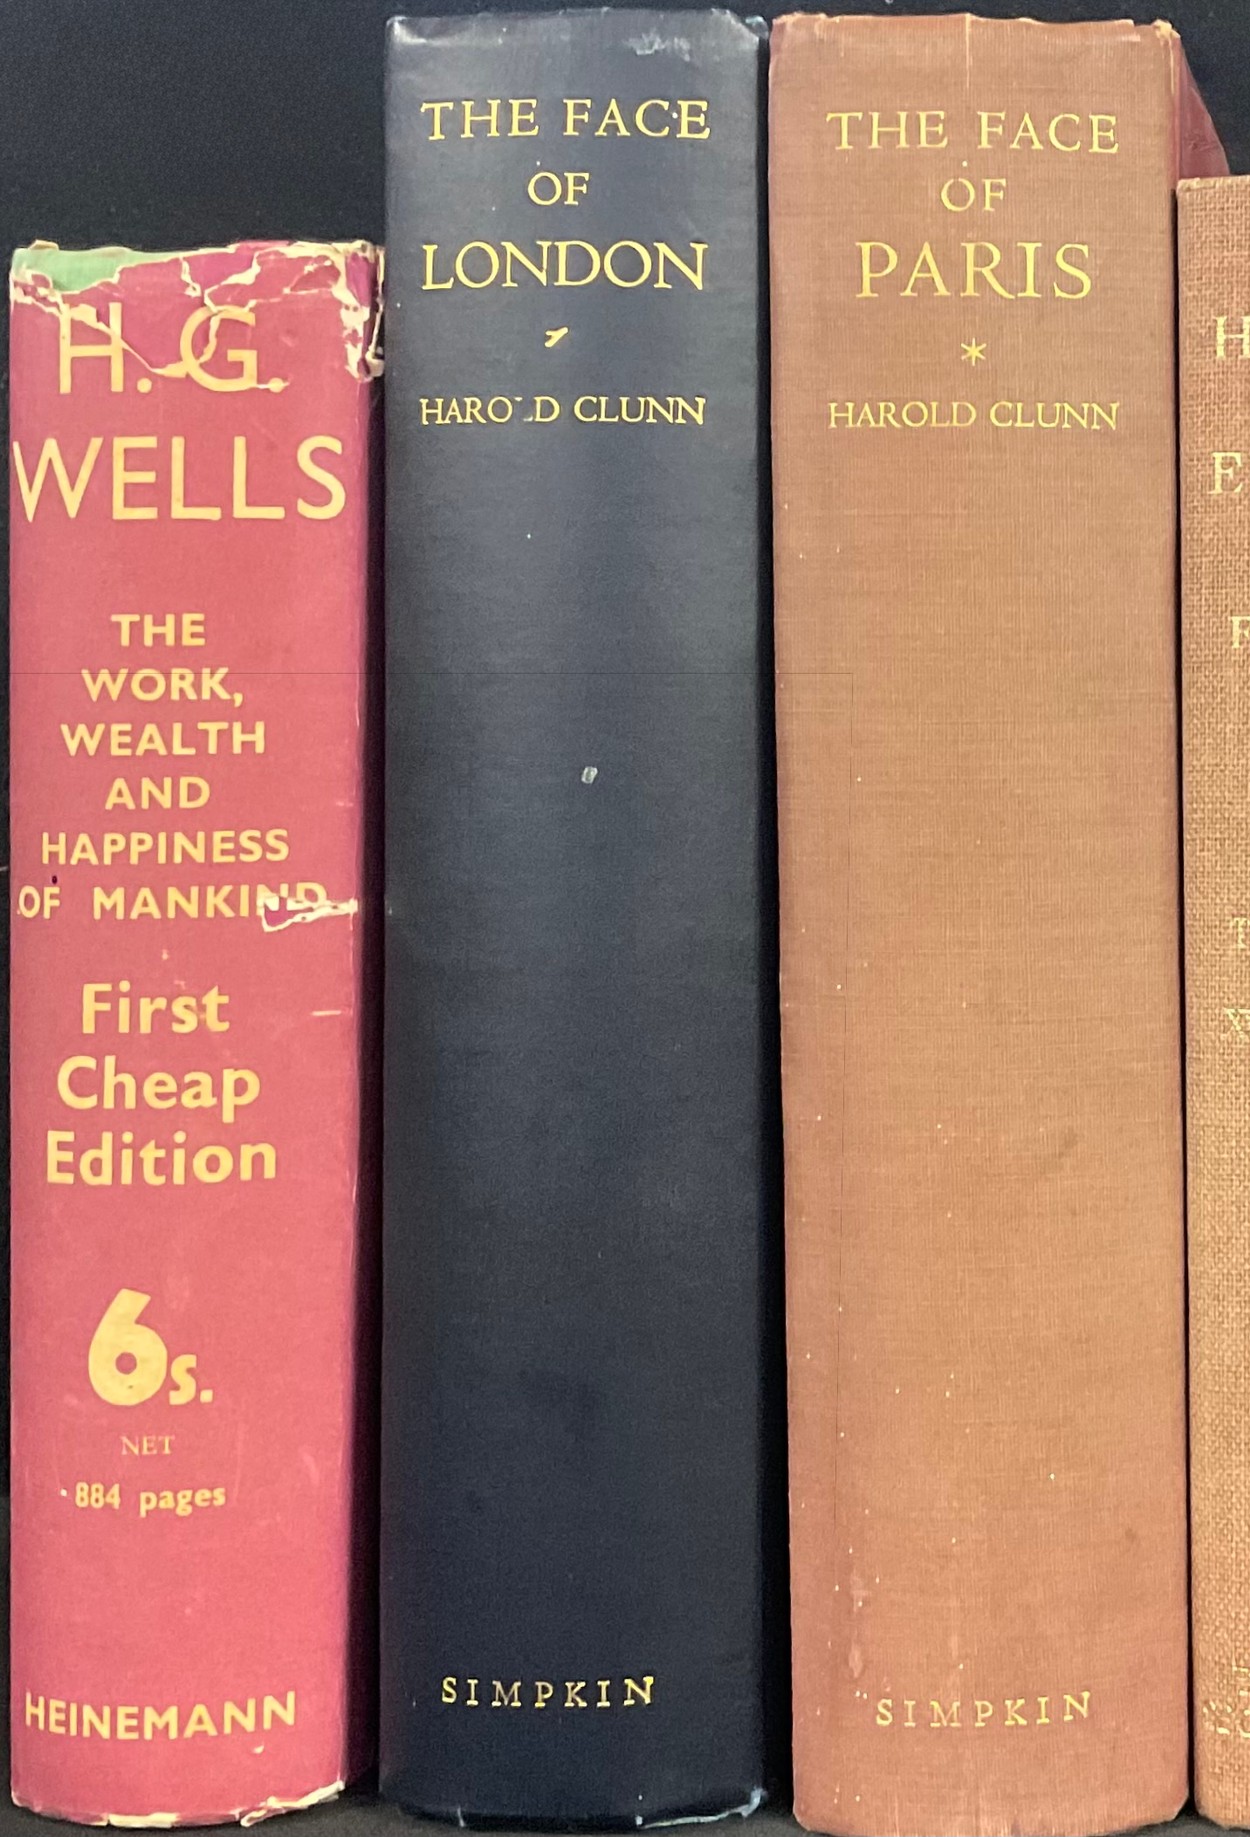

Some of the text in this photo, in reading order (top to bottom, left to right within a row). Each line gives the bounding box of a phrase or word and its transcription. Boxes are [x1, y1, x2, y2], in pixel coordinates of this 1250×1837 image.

[420, 99, 711, 140] THE FACE
[826, 111, 1121, 154] THE FACE
[527, 172, 590, 206] OF
[941, 178, 1008, 212] OF
[421, 241, 708, 291] LONDON
[855, 241, 1094, 300] PARIS
[419, 396, 706, 425] HAROD CLUNN
[828, 402, 1120, 430] HAROLD CLUNN
[12, 436, 346, 523] WELLS
[111, 613, 206, 647] THE
[81, 667, 243, 706] WORK,
[61, 722, 266, 756] WEALTH
[105, 776, 211, 809] AND
[42, 828, 289, 865] HAPPINESS
[18, 885, 60, 919] OF
[82, 982, 230, 1034] First
[56, 1057, 261, 1122] Cheap
[46, 1131, 277, 1186] Edition
[87, 1288, 213, 1406] 6s.
[121, 1434, 174, 1456] NET
[74, 1483, 227, 1514] 884 pages
[442, 1676, 655, 1708] SIMPKIN
[875, 1691, 1092, 1728] SIMPKIN
[25, 1691, 297, 1740] HEINEMANN
